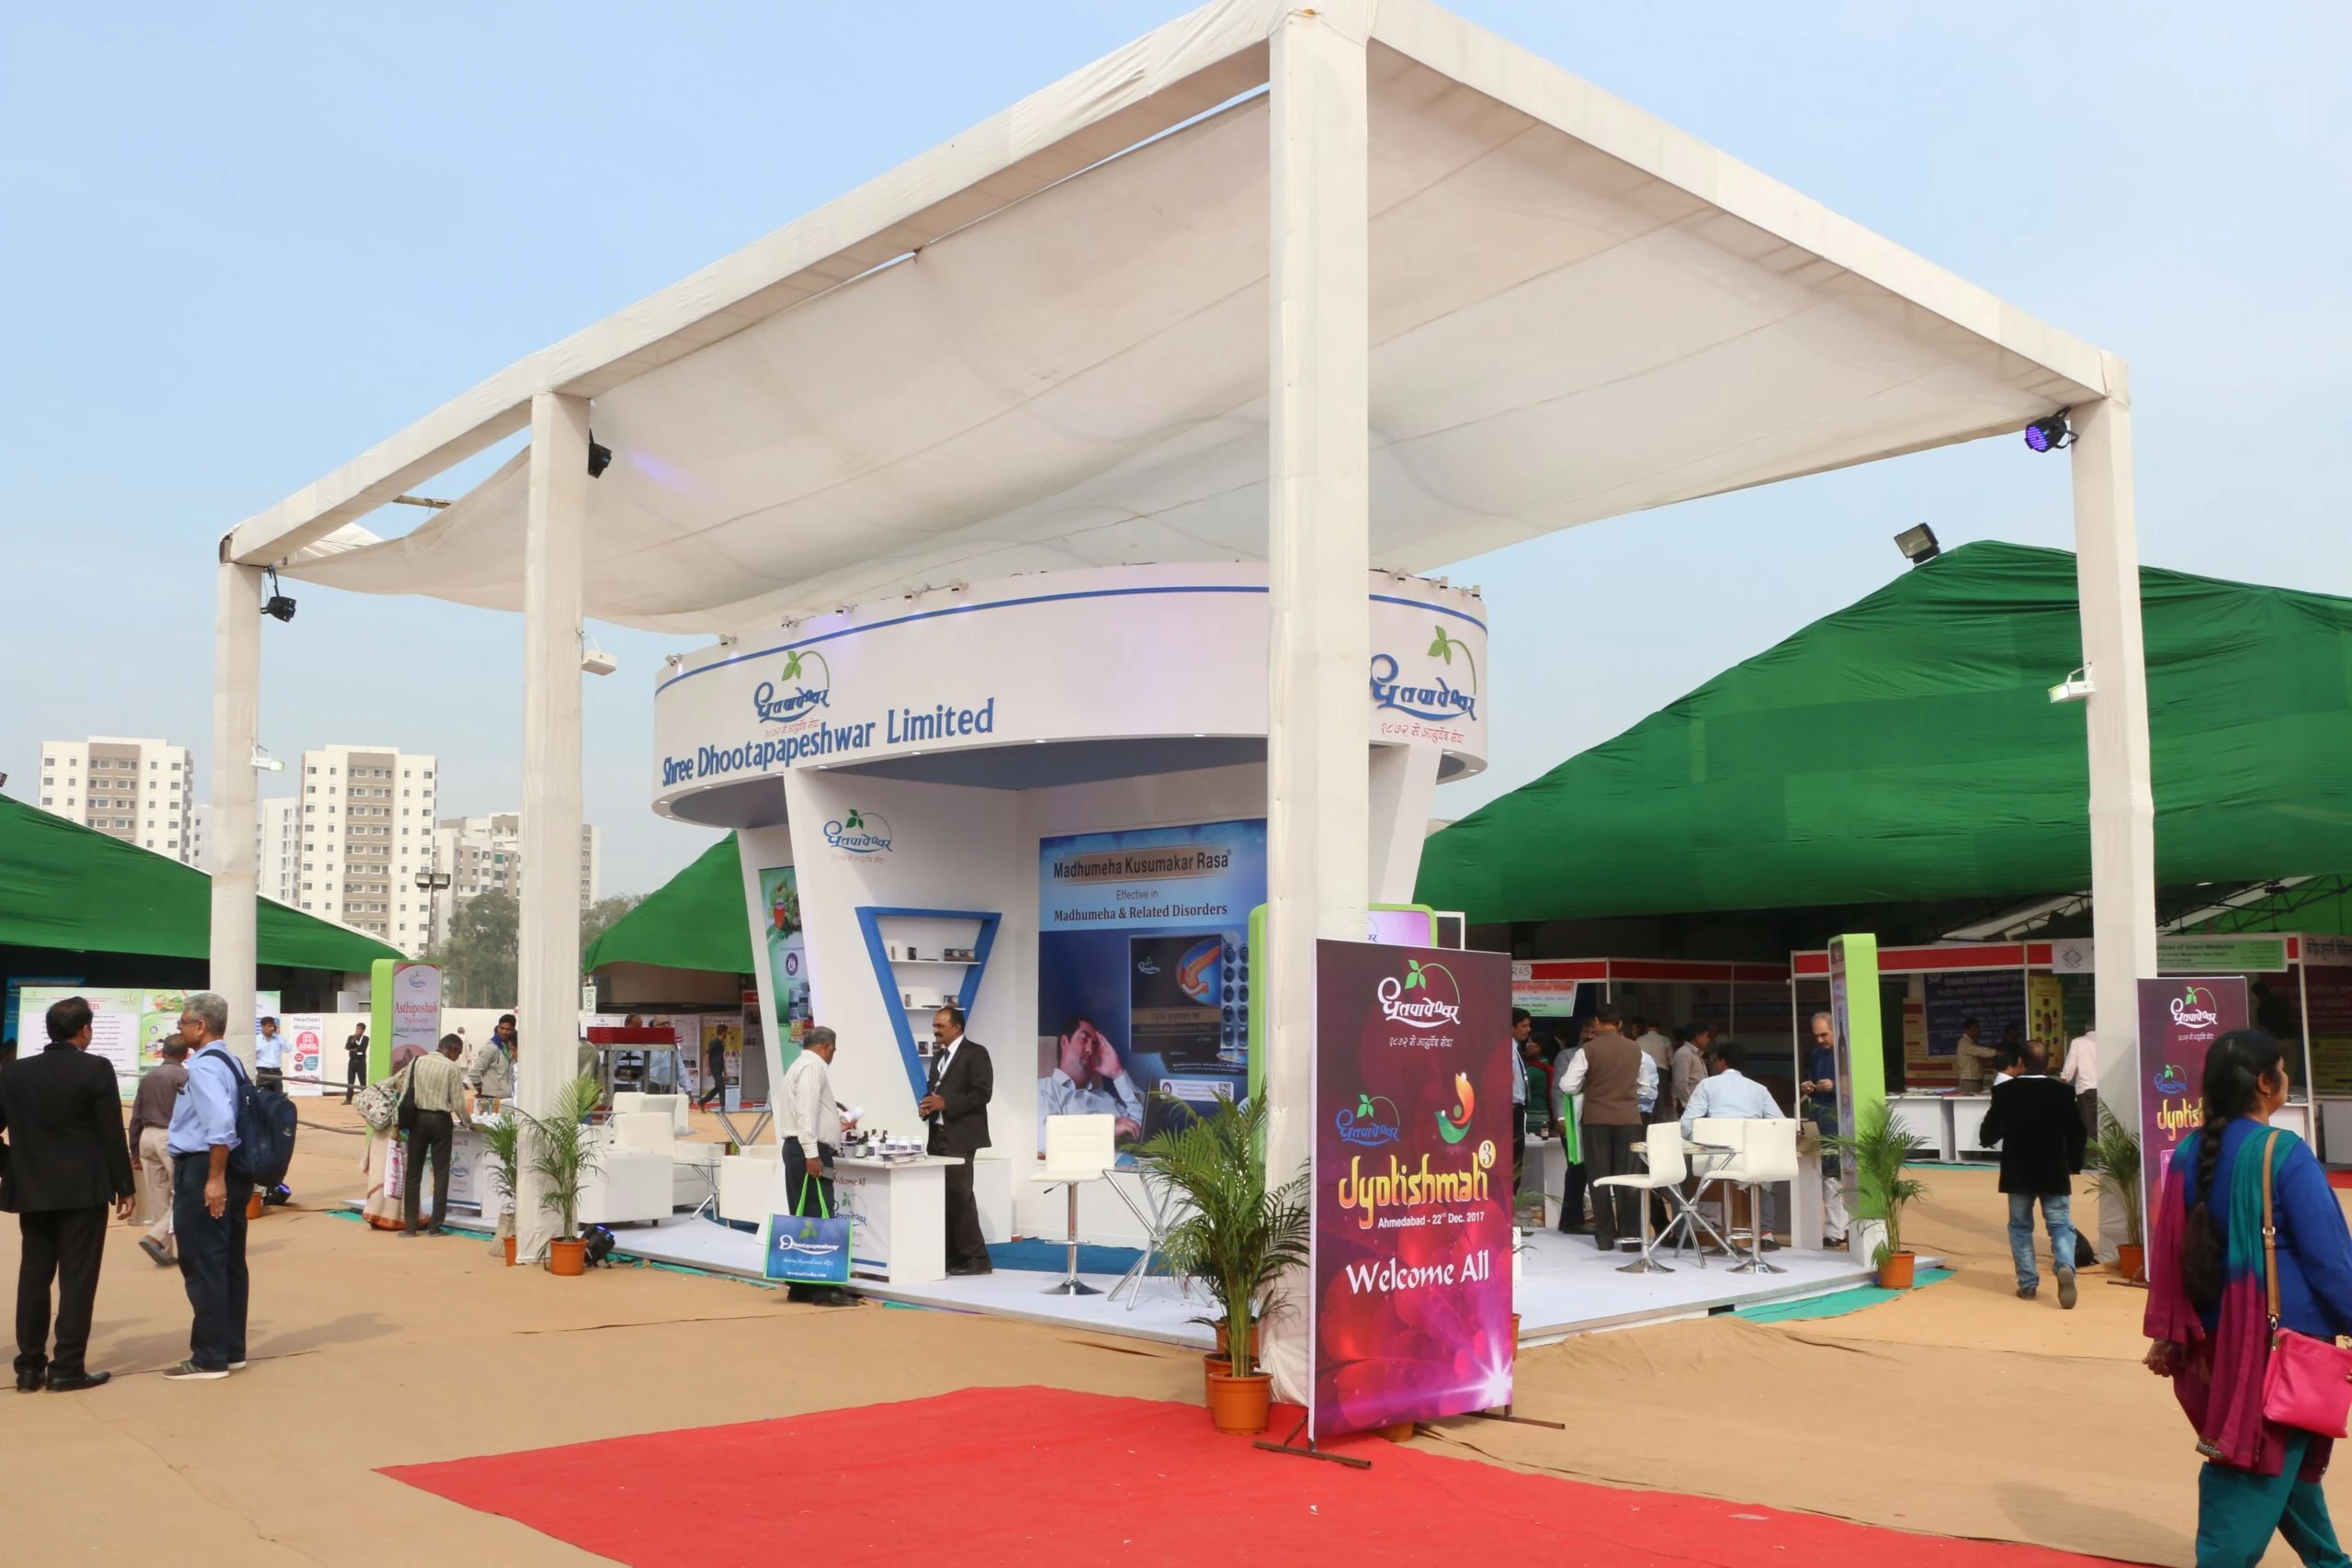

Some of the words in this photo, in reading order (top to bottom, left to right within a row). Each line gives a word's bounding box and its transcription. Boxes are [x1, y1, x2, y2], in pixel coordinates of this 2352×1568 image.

[662, 756, 694, 786] Shree
[697, 721, 876, 777] Dhootapapeshwar
[888, 697, 994, 744] Limited
[1054, 858, 1122, 878] Madhumeha
[1125, 855, 1193, 874] Kusumakar
[1116, 889, 1148, 900] Effective
[1151, 890, 1158, 898] in
[1054, 908, 1115, 921] Madhumeha
[1118, 908, 1126, 919] &
[1129, 904, 1169, 919] Related
[1172, 902, 1228, 917] Disorders
[1378, 1215, 1425, 1229] Ahmedabad
[1448, 1213, 1464, 1224] Dec.
[1466, 1212, 1485, 1223] 2017
[1345, 1257, 1454, 1294] Welcome
[1460, 1249, 1489, 1283] All
